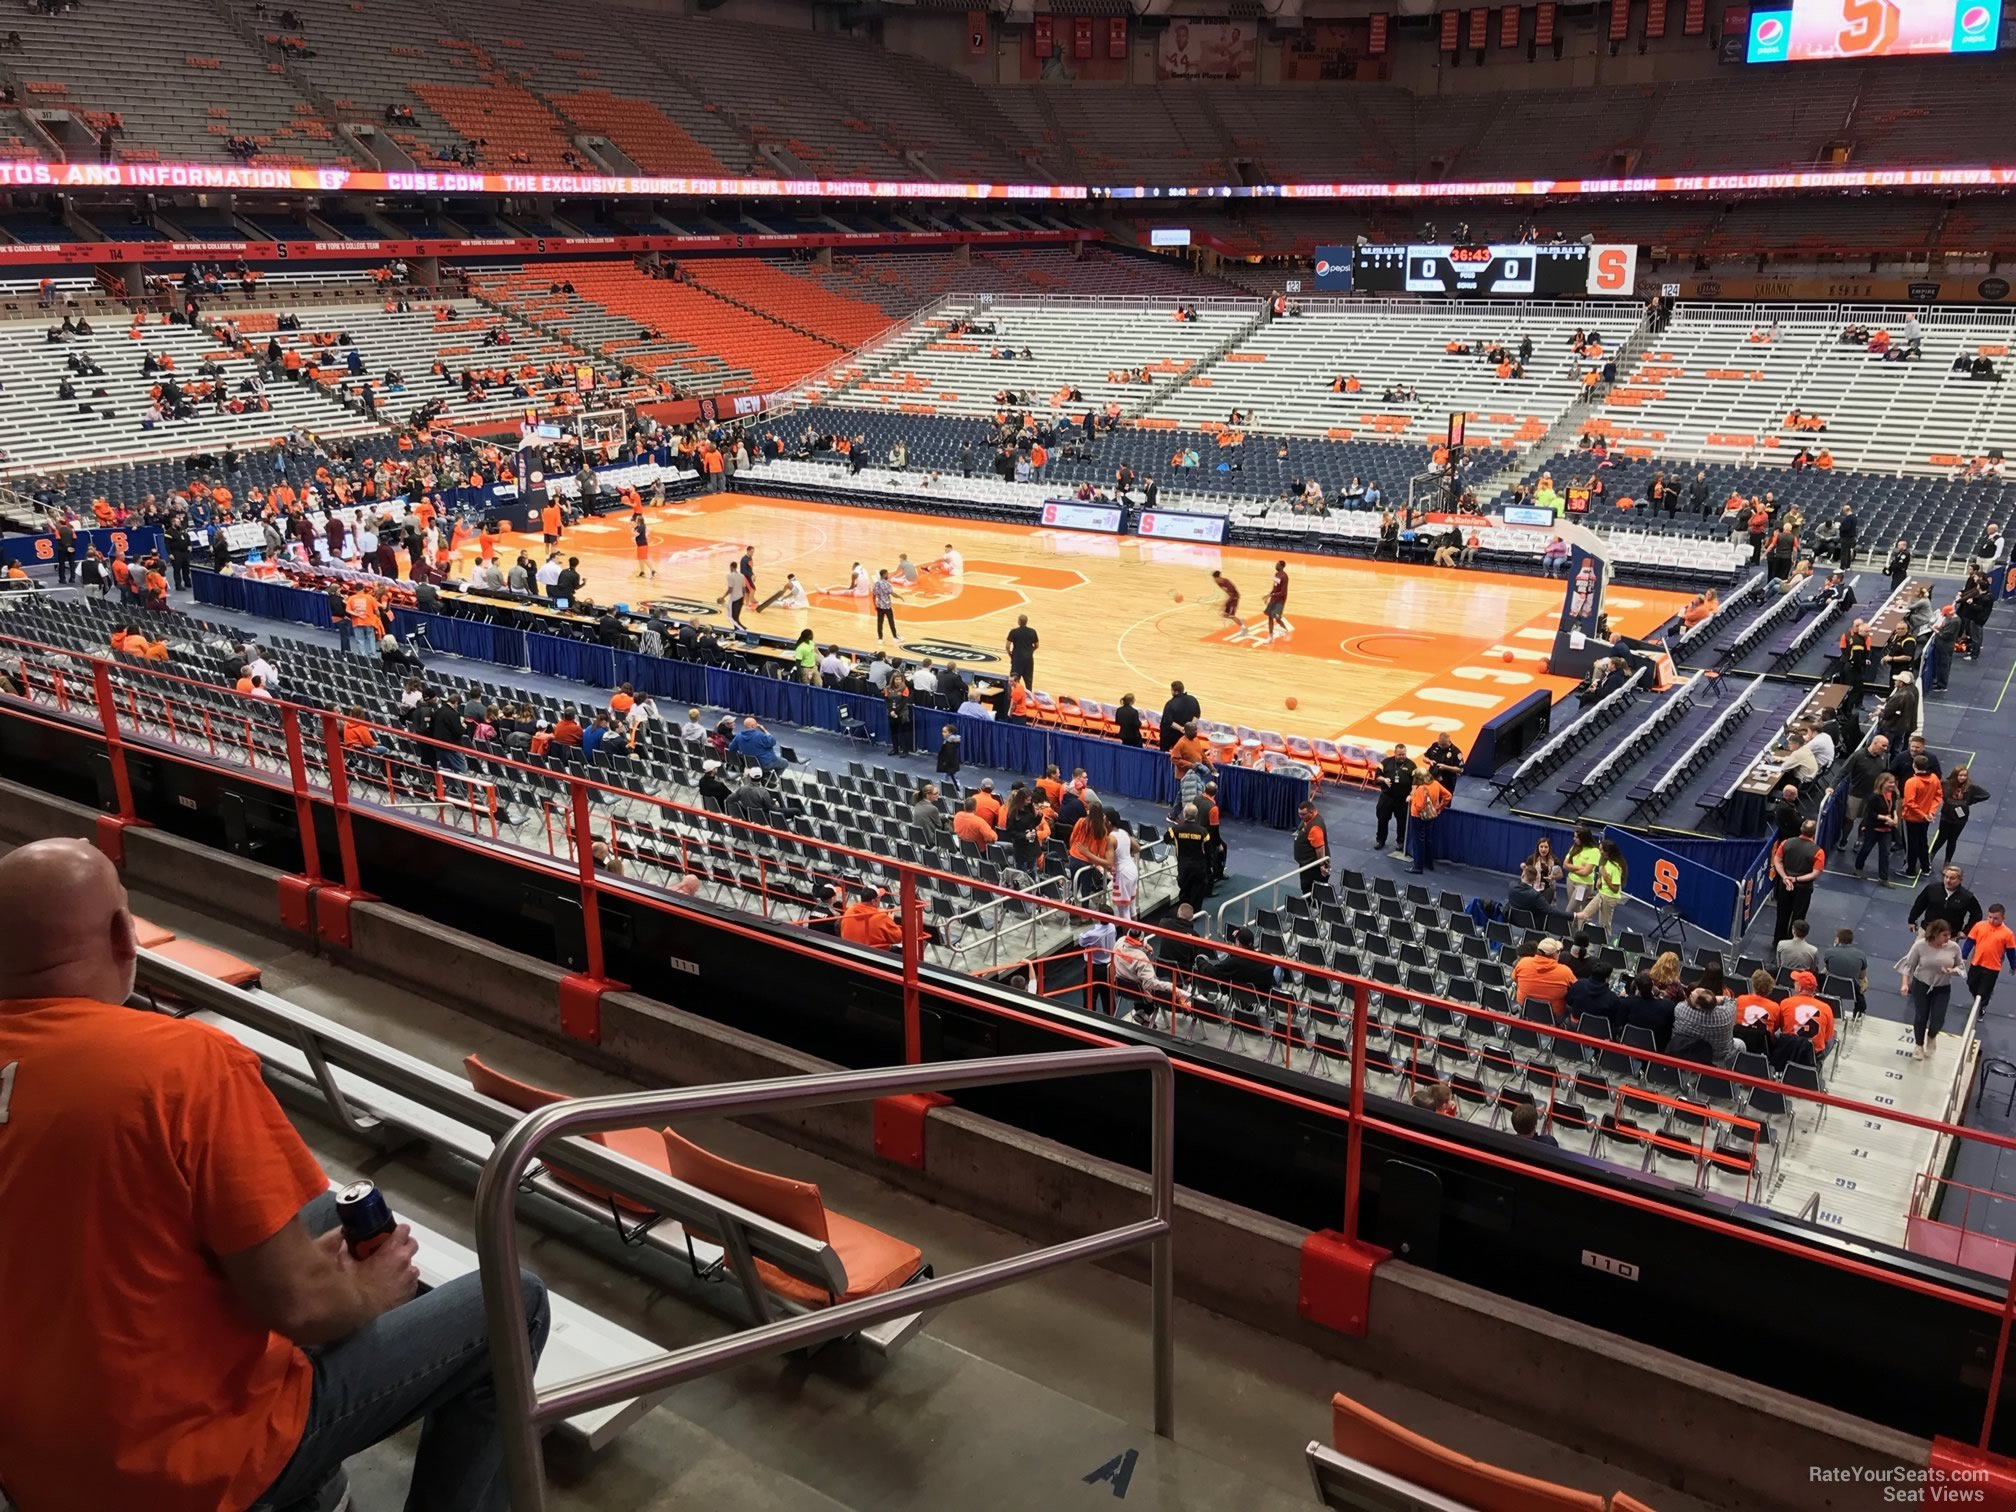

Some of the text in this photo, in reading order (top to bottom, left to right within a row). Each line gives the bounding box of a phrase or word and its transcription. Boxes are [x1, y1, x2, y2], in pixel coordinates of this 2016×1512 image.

[974, 35, 982, 46] 7
[68, 165, 121, 186] AND
[131, 166, 292, 188] INFORMATION
[1674, 177, 1704, 190] THE
[1709, 174, 1794, 189] EXCLUSIVE
[1801, 173, 1865, 187] SOURCE
[1871, 172, 1905, 186] FOR
[1911, 171, 1937, 185] SU
[388, 174, 484, 191] CUSE.COM
[504, 177, 537, 192] THE
[542, 177, 626, 193] EXCLUSIVE
[631, 179, 687, 193] SOURCE
[691, 180, 717, 194] FOR
[721, 180, 738, 194] SU
[876, 183, 898, 197] AND
[900, 183, 967, 197] INFORMATION
[1393, 185, 1421, 196] AND
[1425, 183, 1516, 196] INFORMATION
[537, 240, 546, 253] S
[736, 236, 743, 247] S
[109, 249, 123, 260] 114
[277, 243, 288, 258] S
[1452, 250, 1490, 262] 36:43
[1330, 264, 1350, 273] pepsi
[1422, 259, 1436, 278] 0
[1504, 260, 1519, 279] 0
[1597, 250, 1627, 289] S
[1288, 281, 1299, 291] 123
[1664, 285, 1678, 296] 124
[702, 400, 715, 420] S
[733, 396, 761, 415] NEW
[1045, 505, 1057, 523] S
[1141, 514, 1155, 533] S
[34, 538, 54, 559] S
[111, 532, 128, 554] S
[1653, 858, 1679, 902] S
[675, 959, 695, 972] 111
[1885, 1070, 1903, 1080] CC
[1875, 1095, 1894, 1105] DD
[1864, 1120, 1881, 1130] EE
[1850, 1148, 1868, 1159] FF
[1835, 1177, 1856, 1190] GG
[1819, 1211, 1843, 1225] HH
[1591, 1255, 1632, 1277] 110
[1082, 1448, 1139, 1499] A
